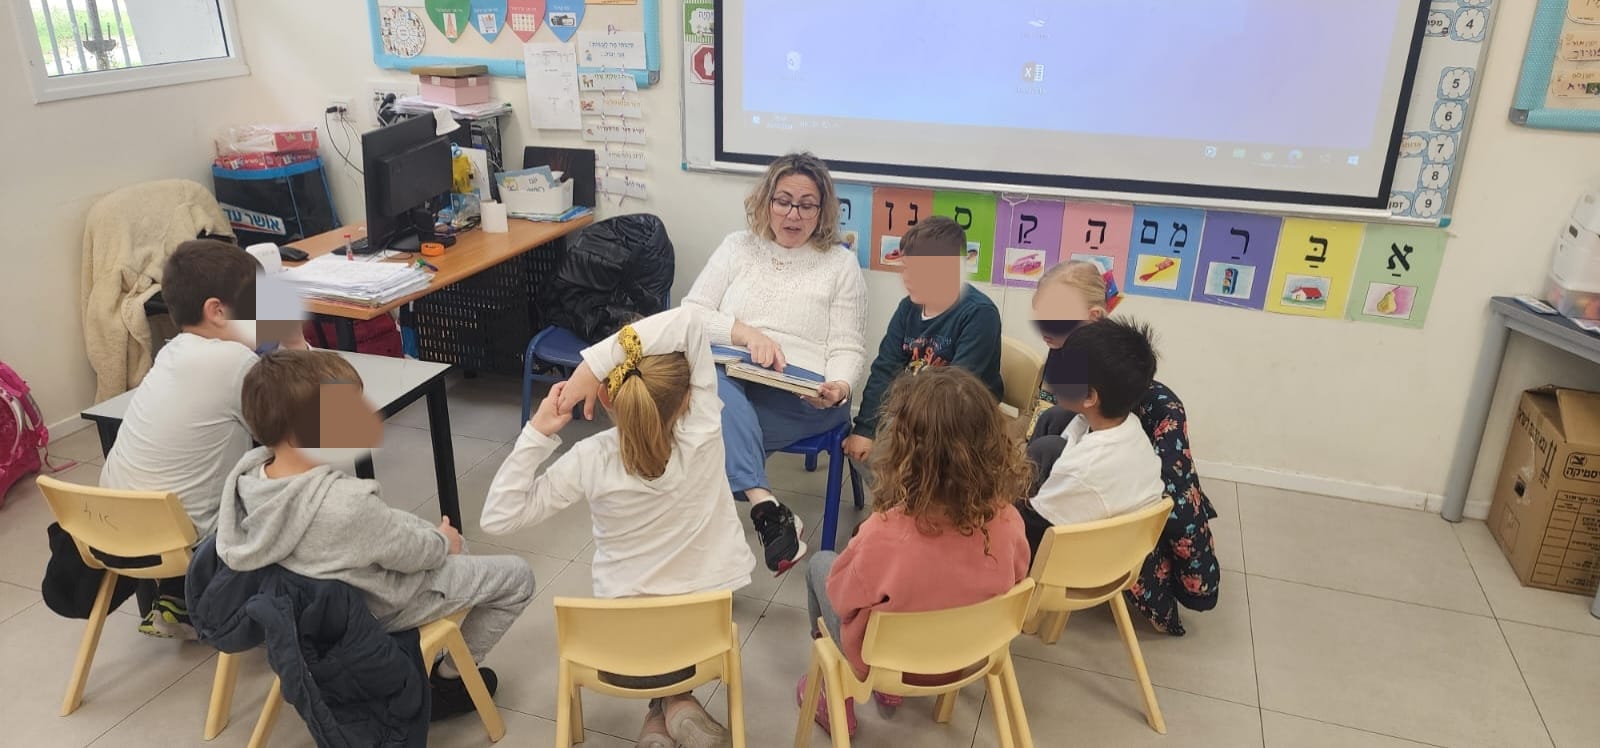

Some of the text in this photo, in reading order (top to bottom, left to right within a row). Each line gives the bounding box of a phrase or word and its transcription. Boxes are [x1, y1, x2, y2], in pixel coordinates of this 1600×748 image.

[1466, 19, 1474, 29] 4
[1452, 79, 1460, 88] 5
[1444, 112, 1452, 121] 6
[1437, 144, 1445, 153] 7
[1431, 171, 1439, 181] 8
[1424, 199, 1432, 208] 9
[908, 202, 918, 226] נ
[244, 212, 281, 231] אושר
[1140, 219, 1159, 245] ם
